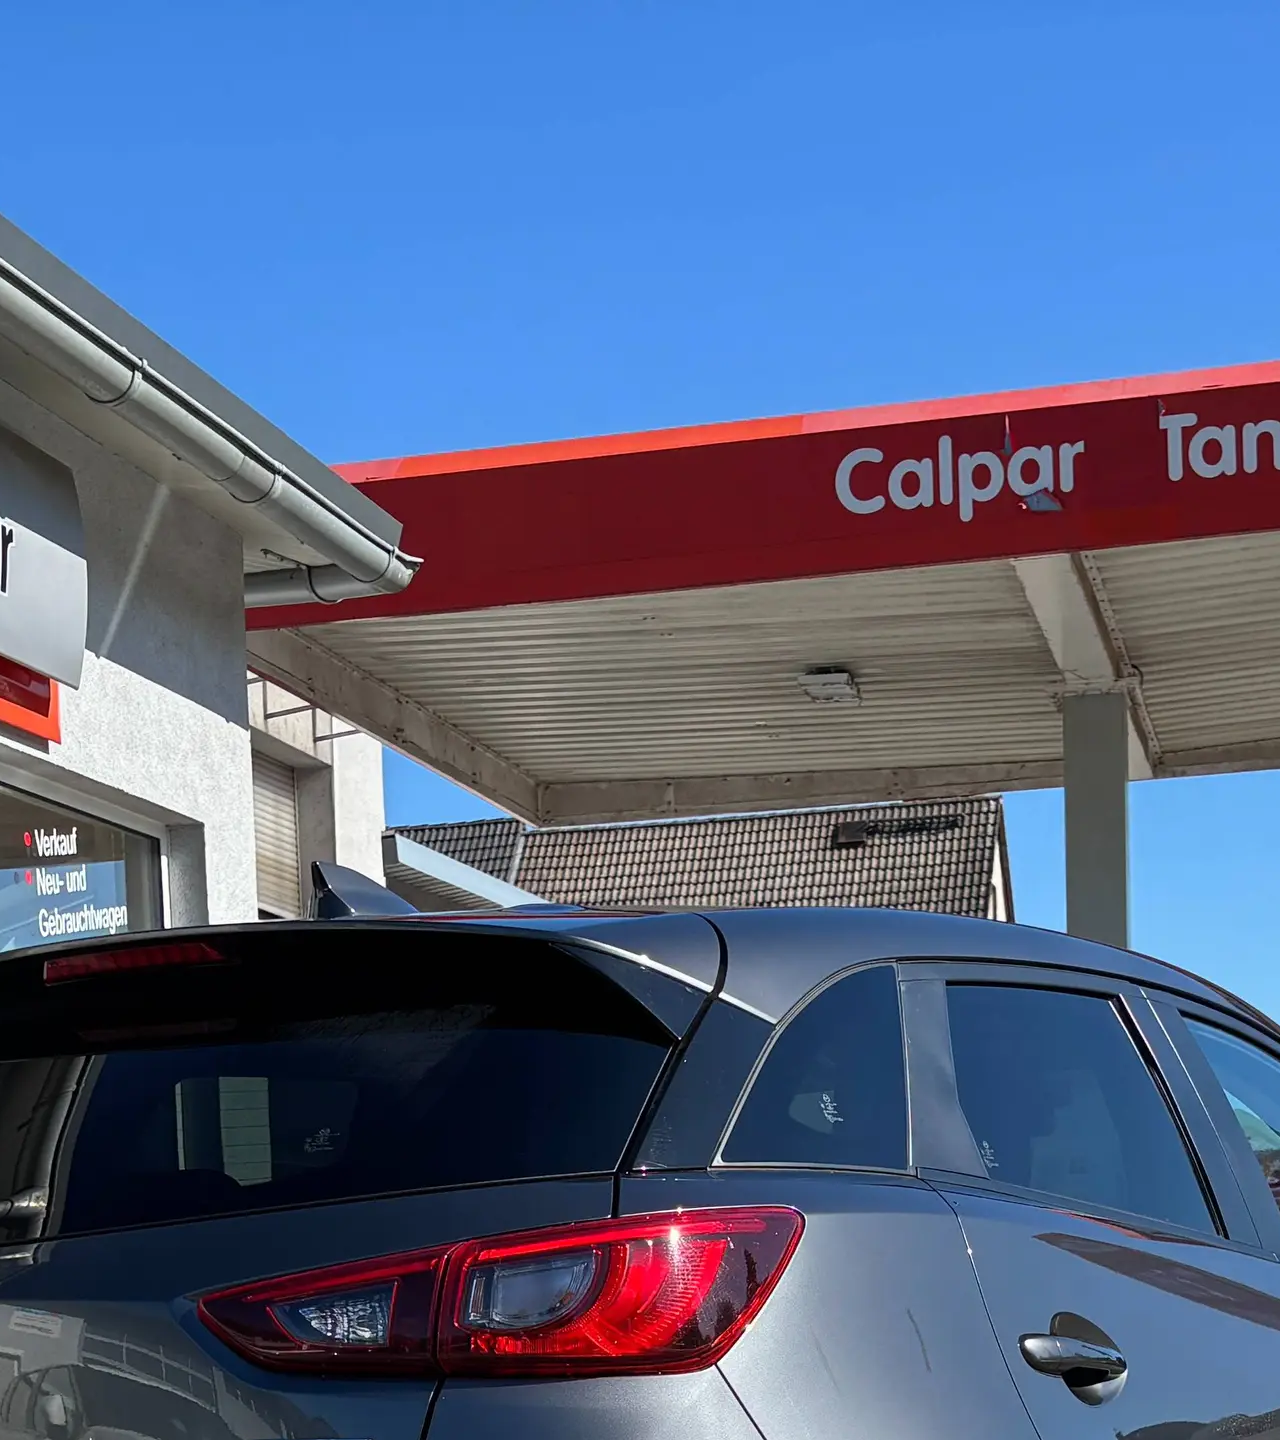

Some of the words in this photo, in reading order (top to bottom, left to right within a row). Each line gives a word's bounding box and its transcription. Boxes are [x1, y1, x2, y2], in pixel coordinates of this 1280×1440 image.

[835, 434, 1086, 522] Calpar
[34, 827, 77, 857] Verkauf
[36, 868, 64, 896] Neu-
[67, 864, 86, 892] und
[39, 904, 128, 937] Gebrauchtwagen
